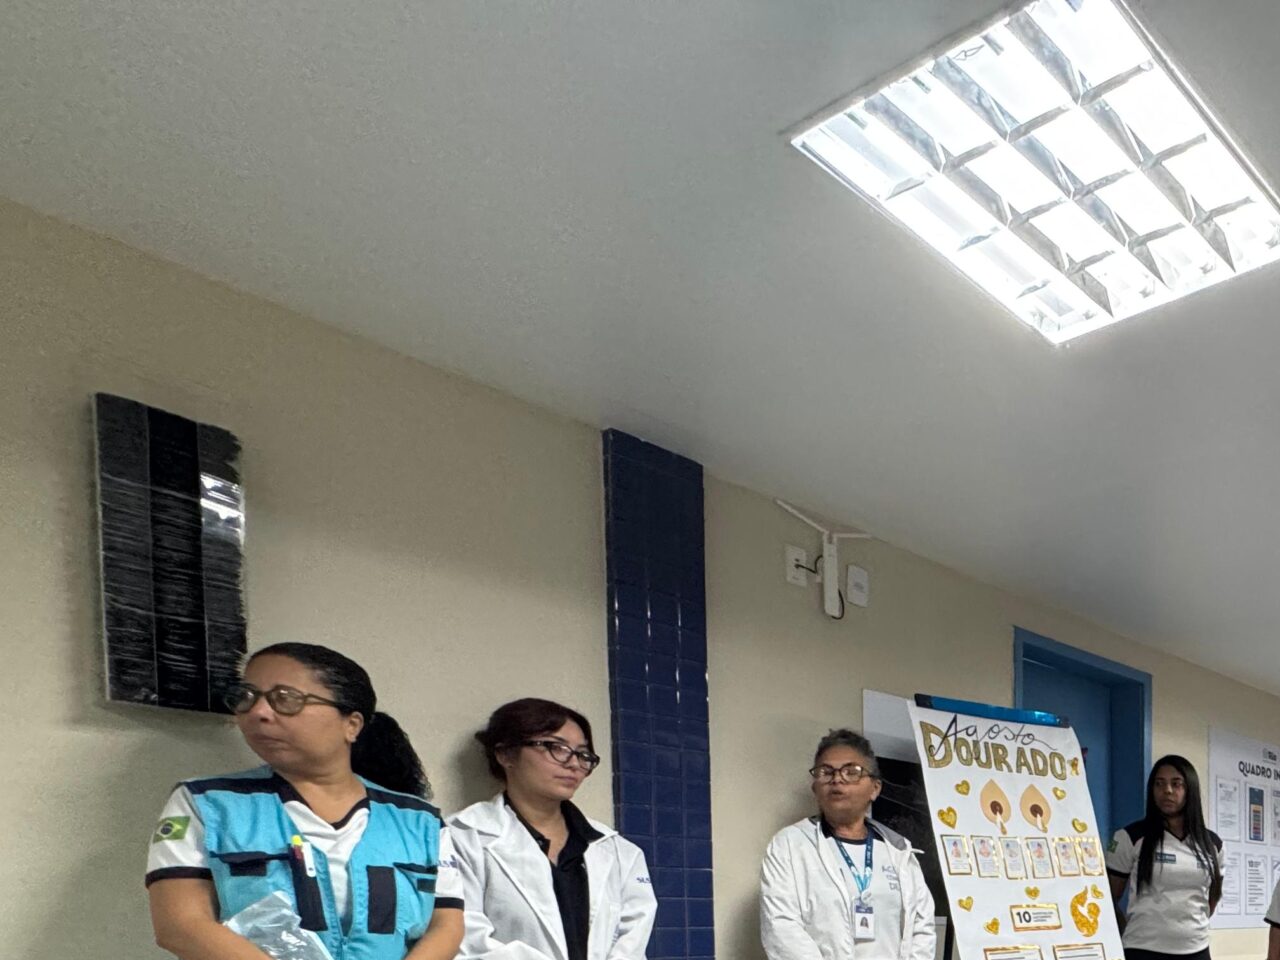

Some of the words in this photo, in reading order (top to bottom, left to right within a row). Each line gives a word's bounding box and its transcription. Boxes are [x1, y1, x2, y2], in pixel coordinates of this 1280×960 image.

[928, 713, 1057, 757] Agosto
[919, 721, 1067, 780] DOURADO
[1238, 761, 1272, 778] QUADRO
[1016, 911, 1032, 923] 10
